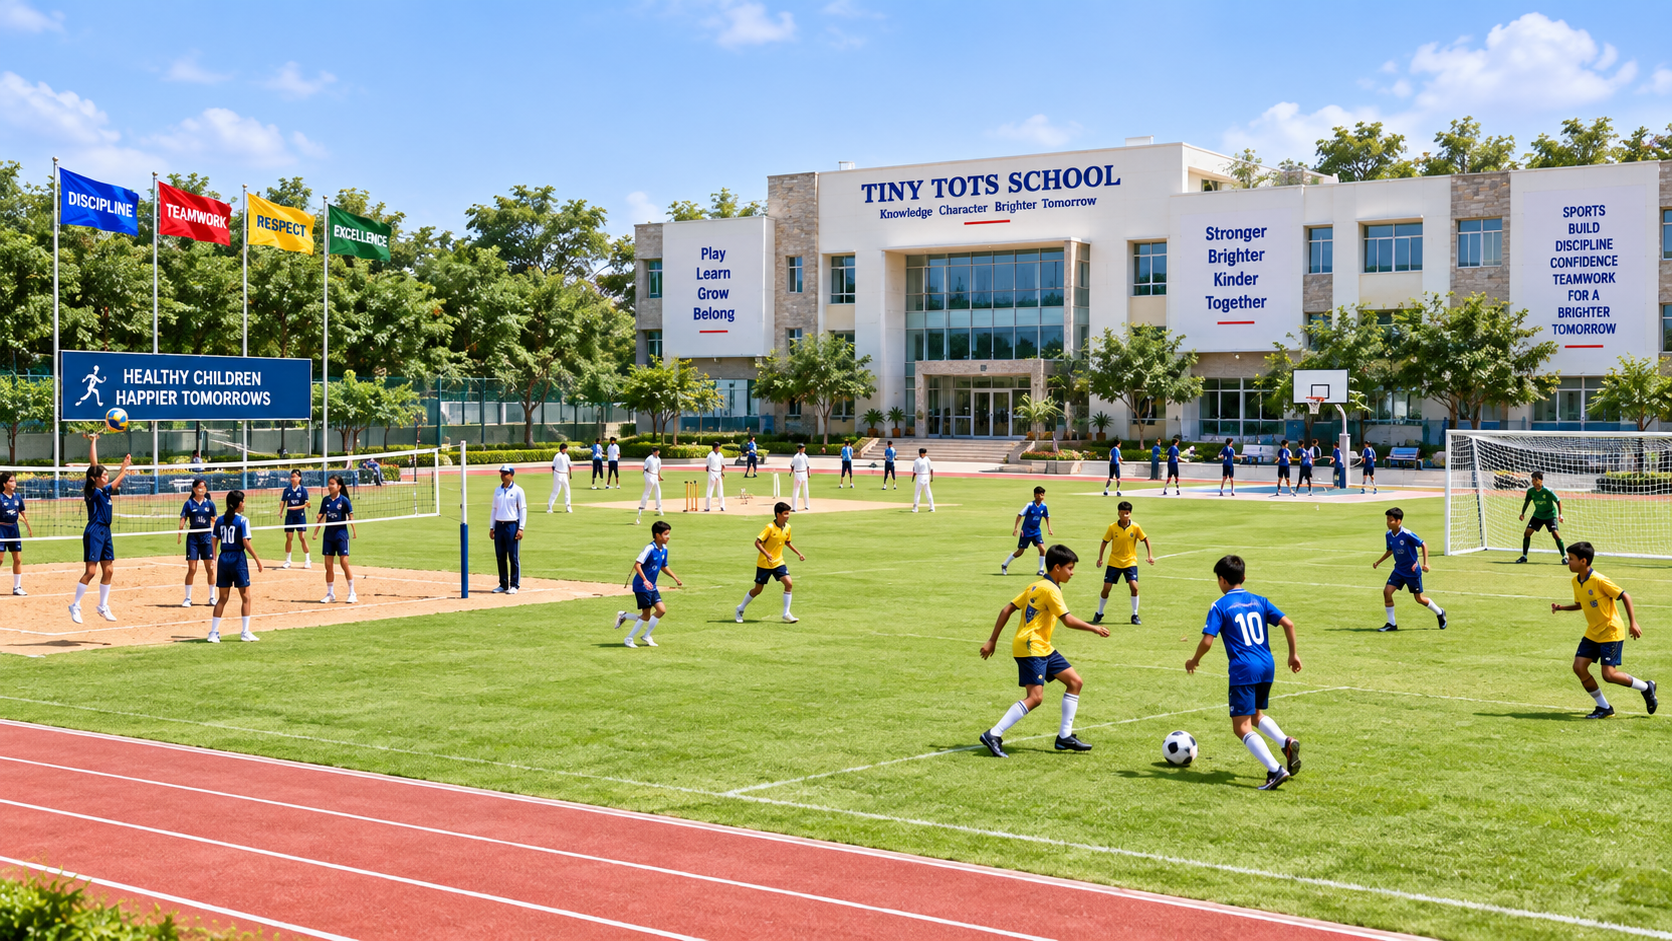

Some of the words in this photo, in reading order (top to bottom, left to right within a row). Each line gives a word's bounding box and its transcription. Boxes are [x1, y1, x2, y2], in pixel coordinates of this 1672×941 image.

[861, 180, 924, 204] TINY
[930, 173, 1000, 199] TOTS
[1007, 164, 1122, 193] SCHOOL
[67, 191, 134, 218] DISCIPLINE
[879, 207, 933, 219] Knowledge
[938, 204, 988, 216] Character
[994, 200, 1038, 214] Brighter
[1042, 196, 1097, 209] Tomorrow
[1562, 204, 1606, 218] SPORTS
[165, 203, 228, 230] TEAMWORK
[256, 214, 307, 237] RESPECT
[1205, 225, 1268, 243] Stronger
[1568, 221, 1601, 235] BUILD
[333, 225, 388, 248] EXCELLENCE
[1555, 237, 1614, 252] DISCIPLINE
[700, 245, 727, 263] Play
[1208, 247, 1266, 267] Brighter
[1549, 254, 1619, 269] CONFIDENCE
[696, 266, 731, 281] Learn
[1213, 271, 1260, 287] Kinder
[1552, 271, 1617, 286] TEAMWORK
[697, 286, 730, 301] Grow
[1567, 289, 1590, 302] FOR
[1592, 289, 1601, 302] A
[1204, 294, 1268, 314] Together
[1557, 305, 1611, 319] BRIGHTER
[693, 306, 736, 323] Belong
[1551, 322, 1617, 336] TOMORROW
[123, 369, 188, 385] HEALTHY
[193, 370, 261, 386] CHILDREN
[115, 389, 177, 406] HAPPIER
[181, 390, 271, 406] TOMORROWS
[1234, 611, 1265, 646] 10
